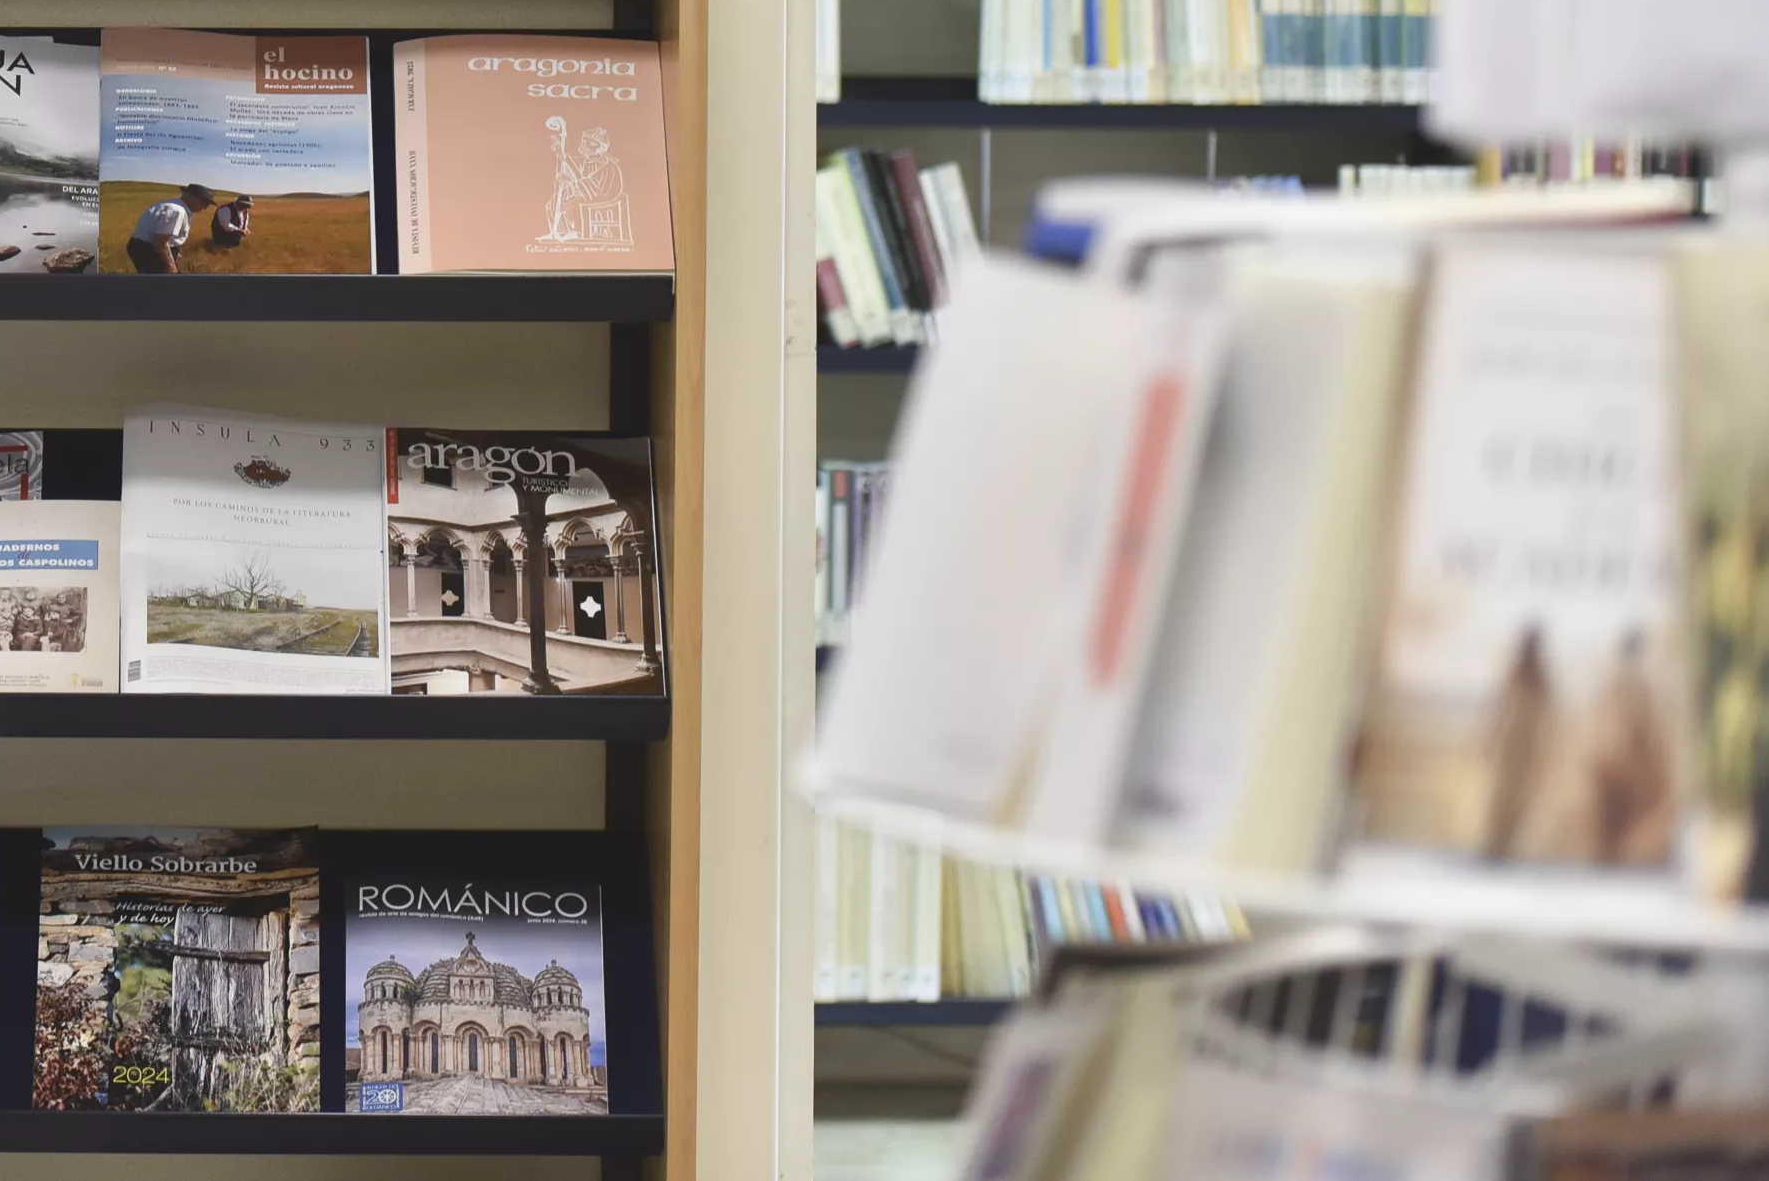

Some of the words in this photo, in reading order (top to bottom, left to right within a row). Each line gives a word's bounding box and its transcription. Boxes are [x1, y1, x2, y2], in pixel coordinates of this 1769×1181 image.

[263, 47, 286, 63] el
[264, 64, 354, 81] hocino
[467, 56, 636, 78] aragonia
[527, 83, 638, 102] sacra
[319, 438, 376, 452] 933
[172, 497, 192, 506] POR
[194, 500, 213, 509] LOS
[215, 502, 260, 514] CAMINOS
[262, 507, 275, 515] DE
[277, 508, 291, 516] LA
[293, 509, 352, 518] LITERATURA
[18, 559, 94, 567] CASPOLINOS
[75, 853, 144, 872] Viello
[150, 855, 258, 874] Sobrarbe
[115, 900, 174, 913] Historias
[177, 902, 196, 913] de
[197, 904, 227, 917] ayer
[358, 883, 588, 918] ROMÁNICO
[117, 914, 126, 924] y
[130, 913, 148, 923] de
[149, 913, 175, 926] hoy
[112, 1065, 171, 1085] 2024
